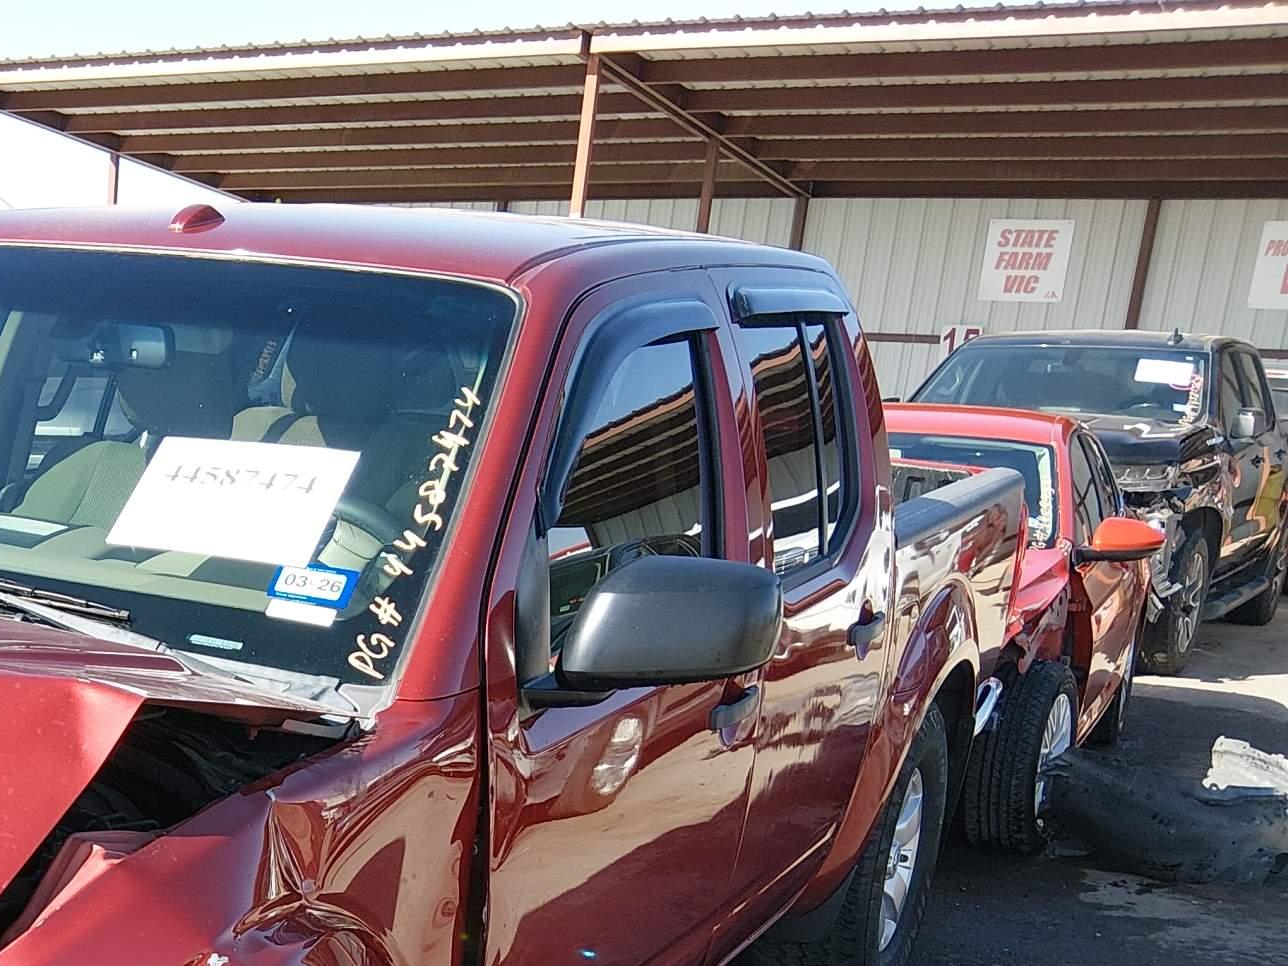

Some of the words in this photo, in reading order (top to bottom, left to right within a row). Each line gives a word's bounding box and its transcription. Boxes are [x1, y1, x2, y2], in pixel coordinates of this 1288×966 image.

[997, 228, 1059, 249] STATE
[994, 251, 1053, 271] FARM
[1002, 274, 1040, 294] VIC
[163, 464, 317, 494] 44587474
[284, 573, 309, 588] 03
[316, 578, 343, 593] 26
